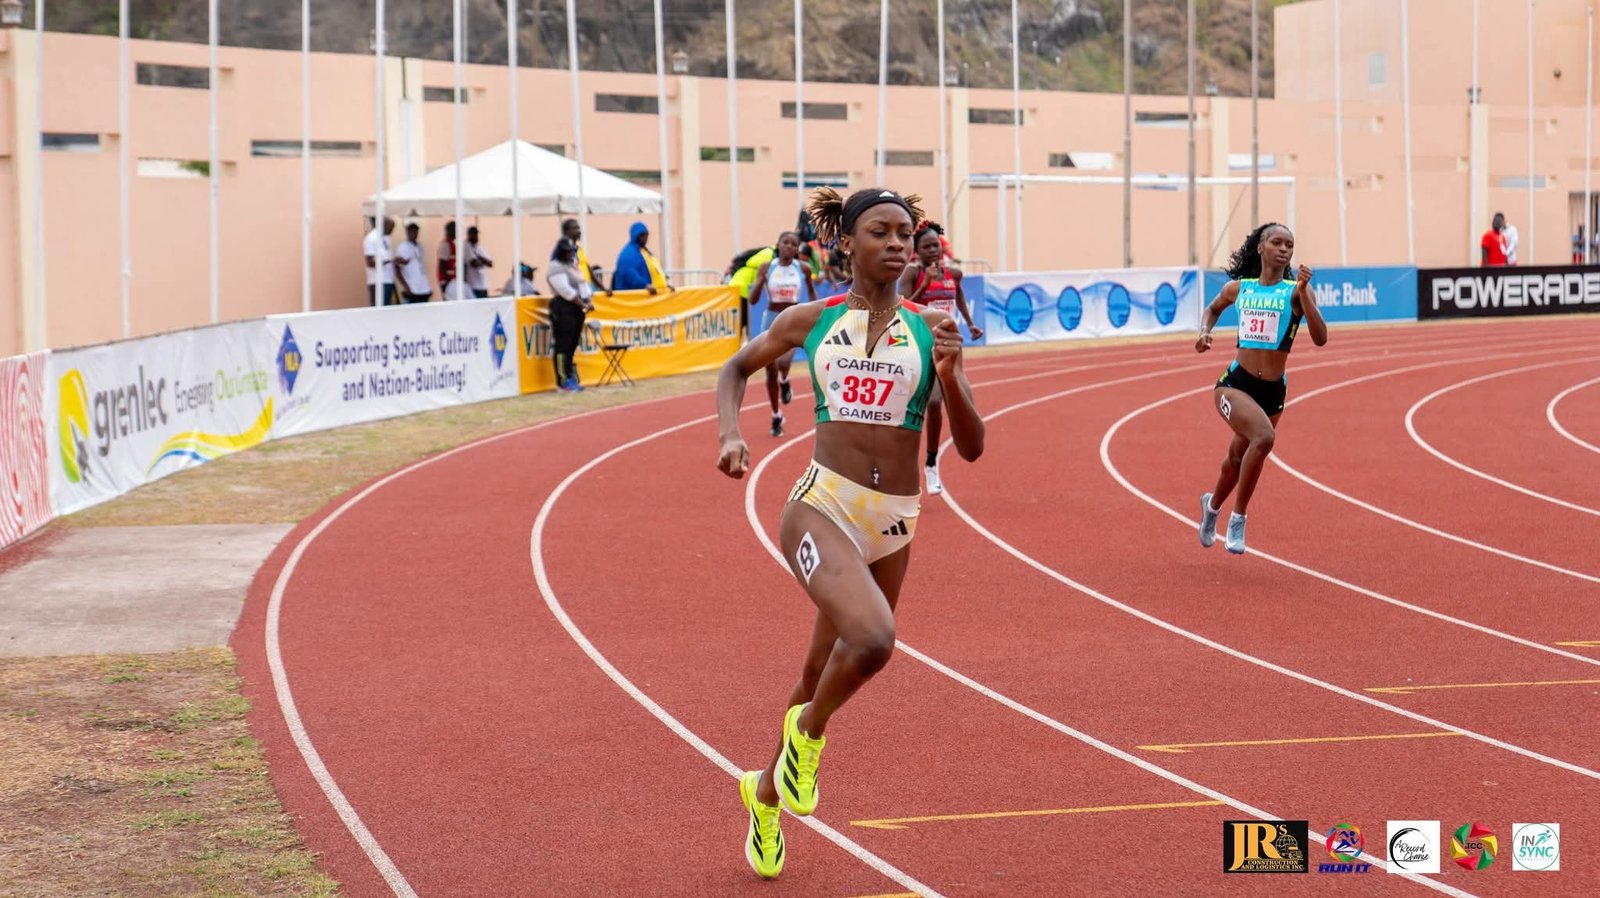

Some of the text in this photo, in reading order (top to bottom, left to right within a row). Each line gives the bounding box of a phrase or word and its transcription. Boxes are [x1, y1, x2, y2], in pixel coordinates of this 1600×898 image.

[1239, 296, 1285, 310] BAHAMAS
[1314, 281, 1377, 306] blic Bank
[1432, 273, 1600, 310] POWERADE
[1243, 309, 1277, 318] CARIFTA
[1250, 318, 1265, 333] 31
[522, 322, 601, 356] VITAALT
[684, 308, 738, 342] VITAMALT
[1244, 333, 1270, 341] GAMES
[315, 331, 479, 371] Supporting Sports, Culture
[837, 358, 904, 376] CARIFTA
[342, 374, 364, 401] and
[369, 363, 466, 397] Nation-Building!
[842, 375, 894, 407] 337
[94, 365, 168, 457] grenlec
[839, 407, 892, 421] GAMES
[1221, 398, 1230, 416] 5
[800, 541, 814, 576] 8
